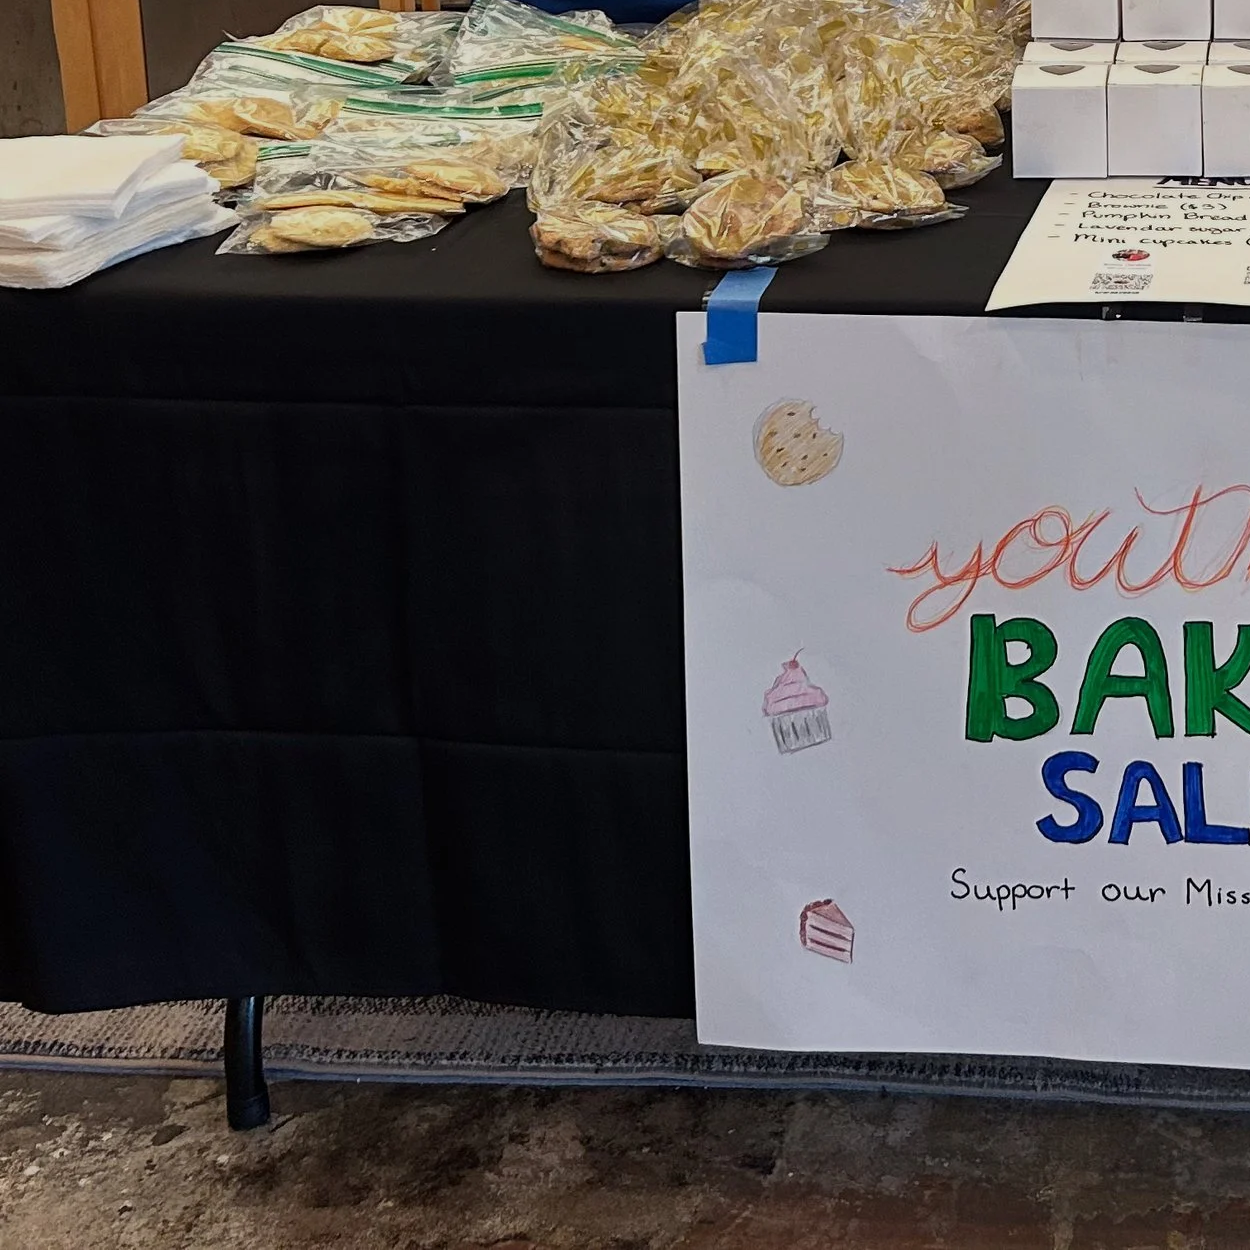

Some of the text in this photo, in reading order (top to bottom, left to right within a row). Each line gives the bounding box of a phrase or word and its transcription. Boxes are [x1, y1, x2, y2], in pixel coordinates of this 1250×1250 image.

[1087, 191, 1201, 200] Chocolate
[1207, 192, 1244, 201] Chip
[1087, 201, 1168, 209] Brownie
[1082, 210, 1172, 221] Pumpkin
[1183, 211, 1248, 220] Bread
[1188, 227, 1247, 235] sugar
[1073, 233, 1127, 244] Mini
[1138, 236, 1233, 247] cupcakes
[950, 868, 1076, 912] Support
[1101, 882, 1166, 903] our
